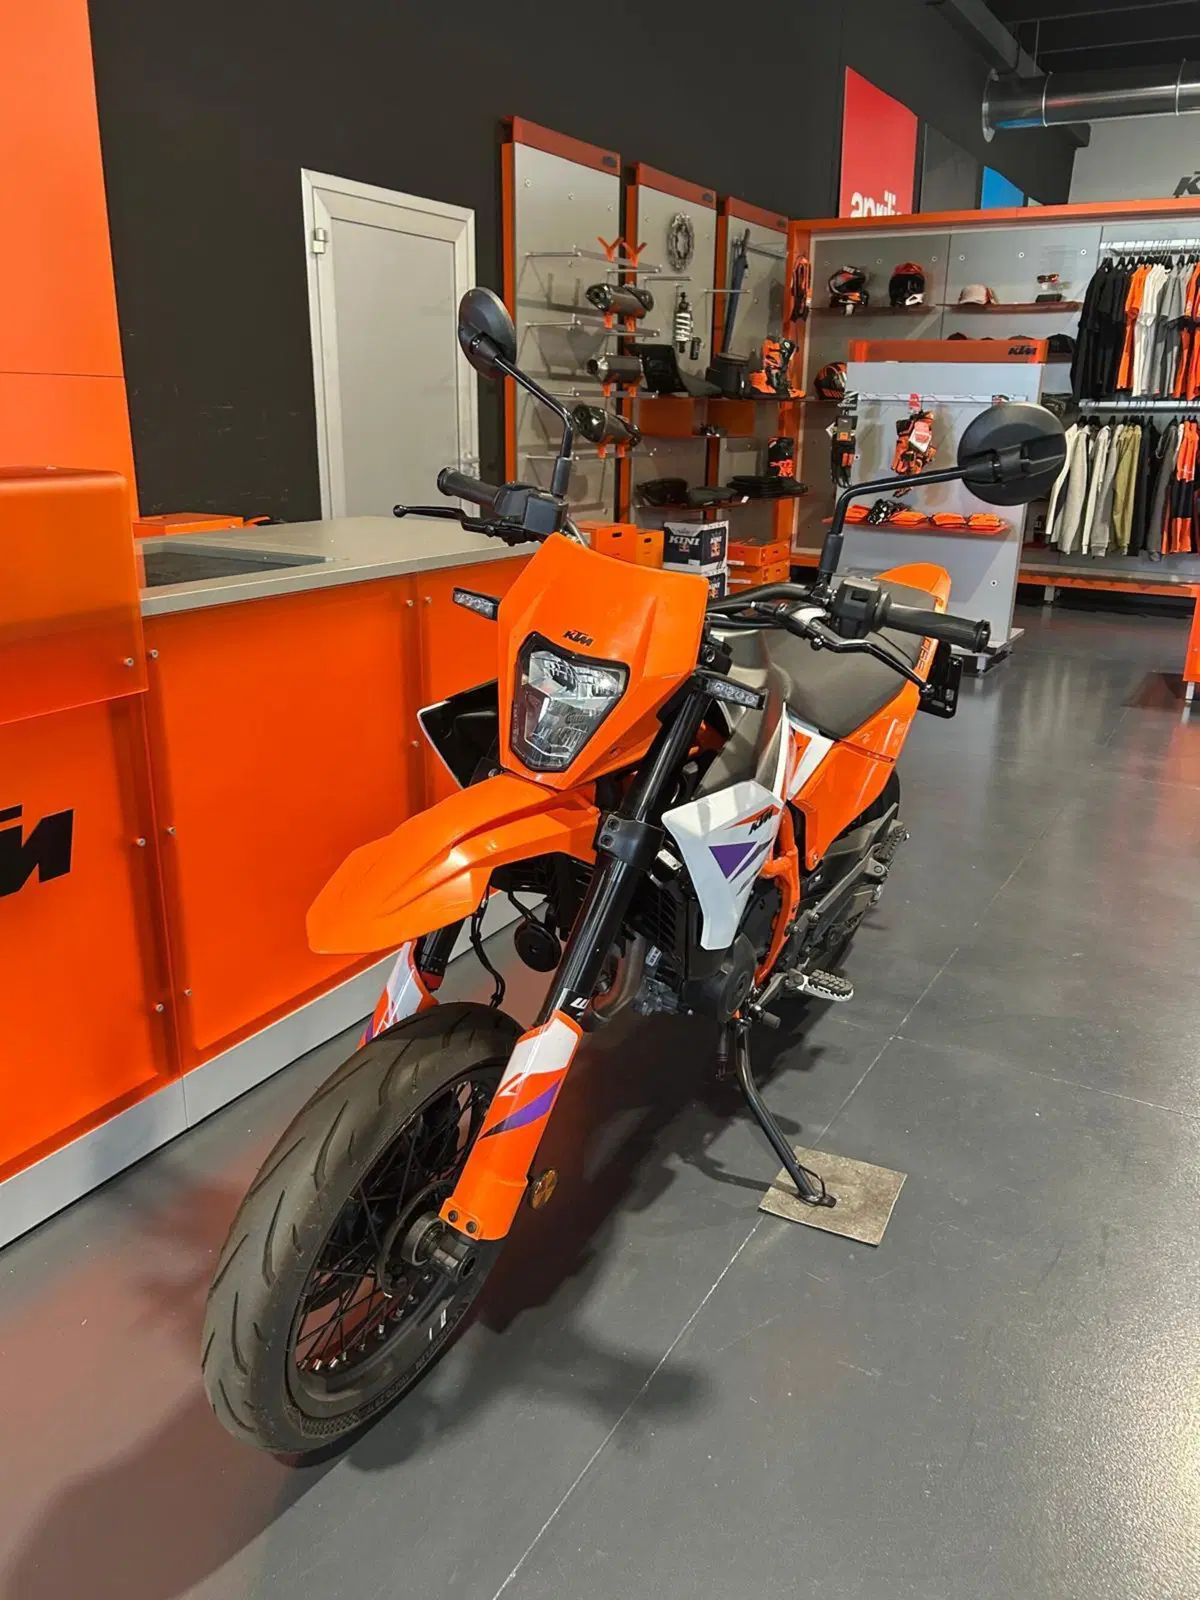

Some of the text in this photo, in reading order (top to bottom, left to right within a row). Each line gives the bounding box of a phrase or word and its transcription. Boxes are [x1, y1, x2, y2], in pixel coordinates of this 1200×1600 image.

[668, 536, 700, 546] KINI
[562, 630, 593, 647] KTM
[748, 808, 774, 836] KTM
